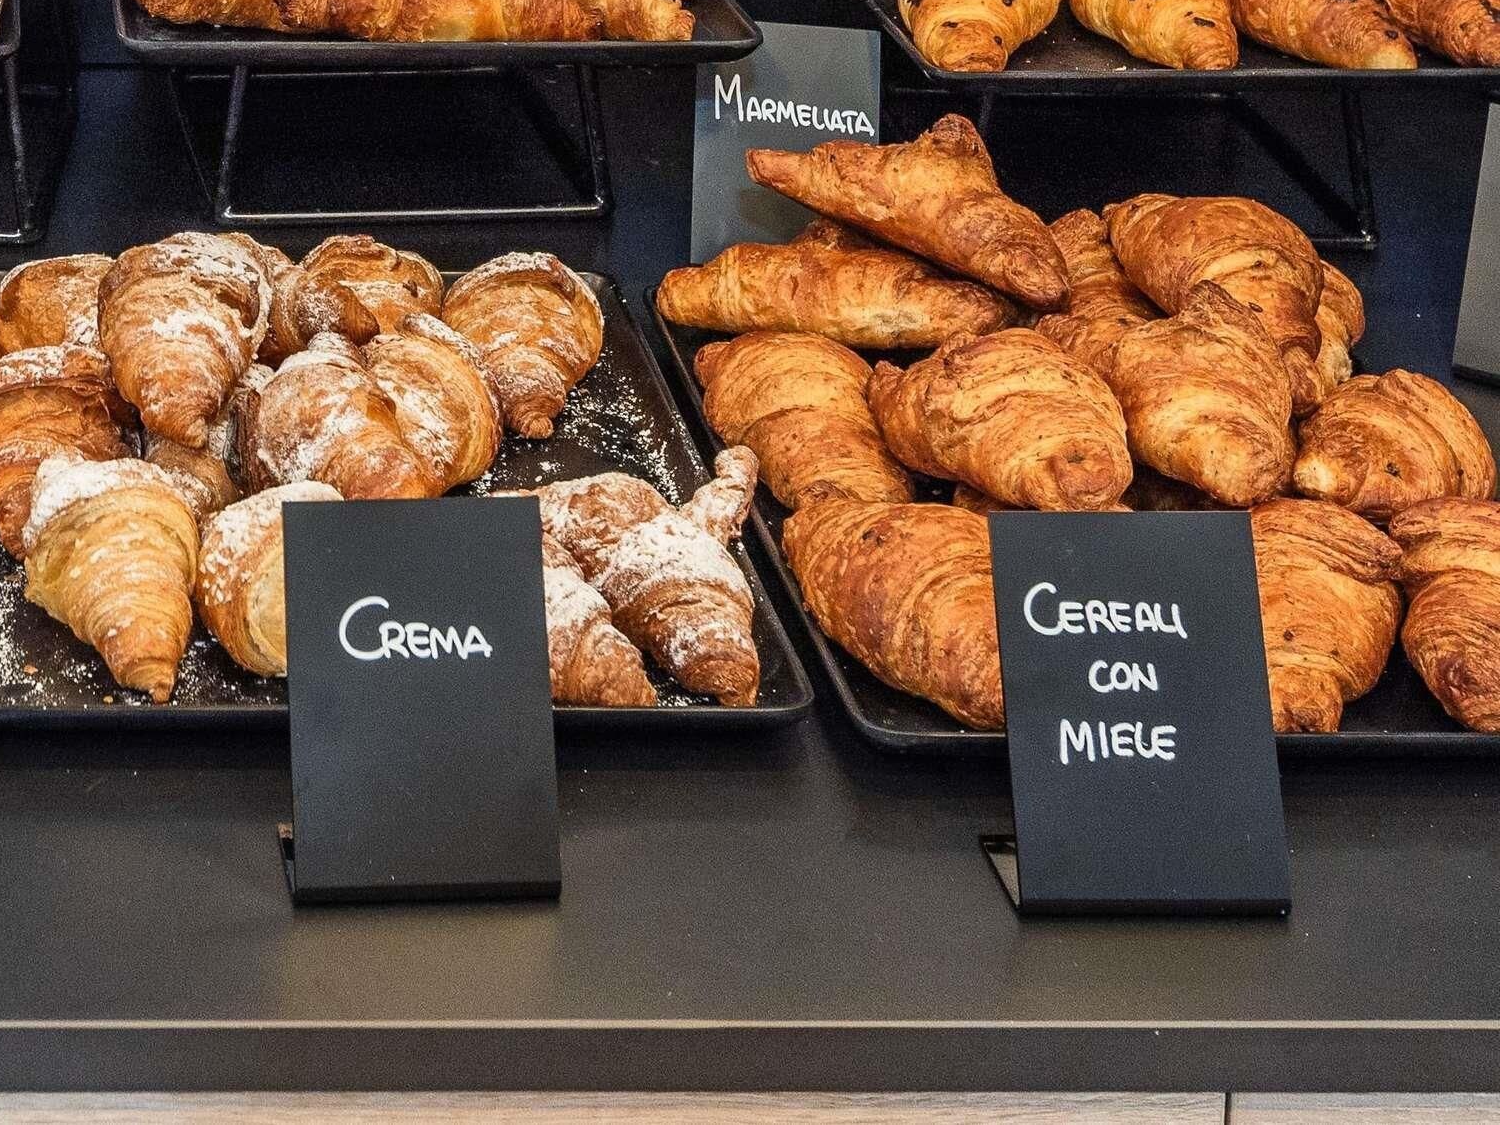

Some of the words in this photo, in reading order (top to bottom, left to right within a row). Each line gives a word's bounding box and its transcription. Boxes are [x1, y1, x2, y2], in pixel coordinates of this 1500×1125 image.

[338, 594, 493, 661] CREMA
[1088, 660, 1159, 693] CON
[1058, 718, 1177, 766] MIELE
